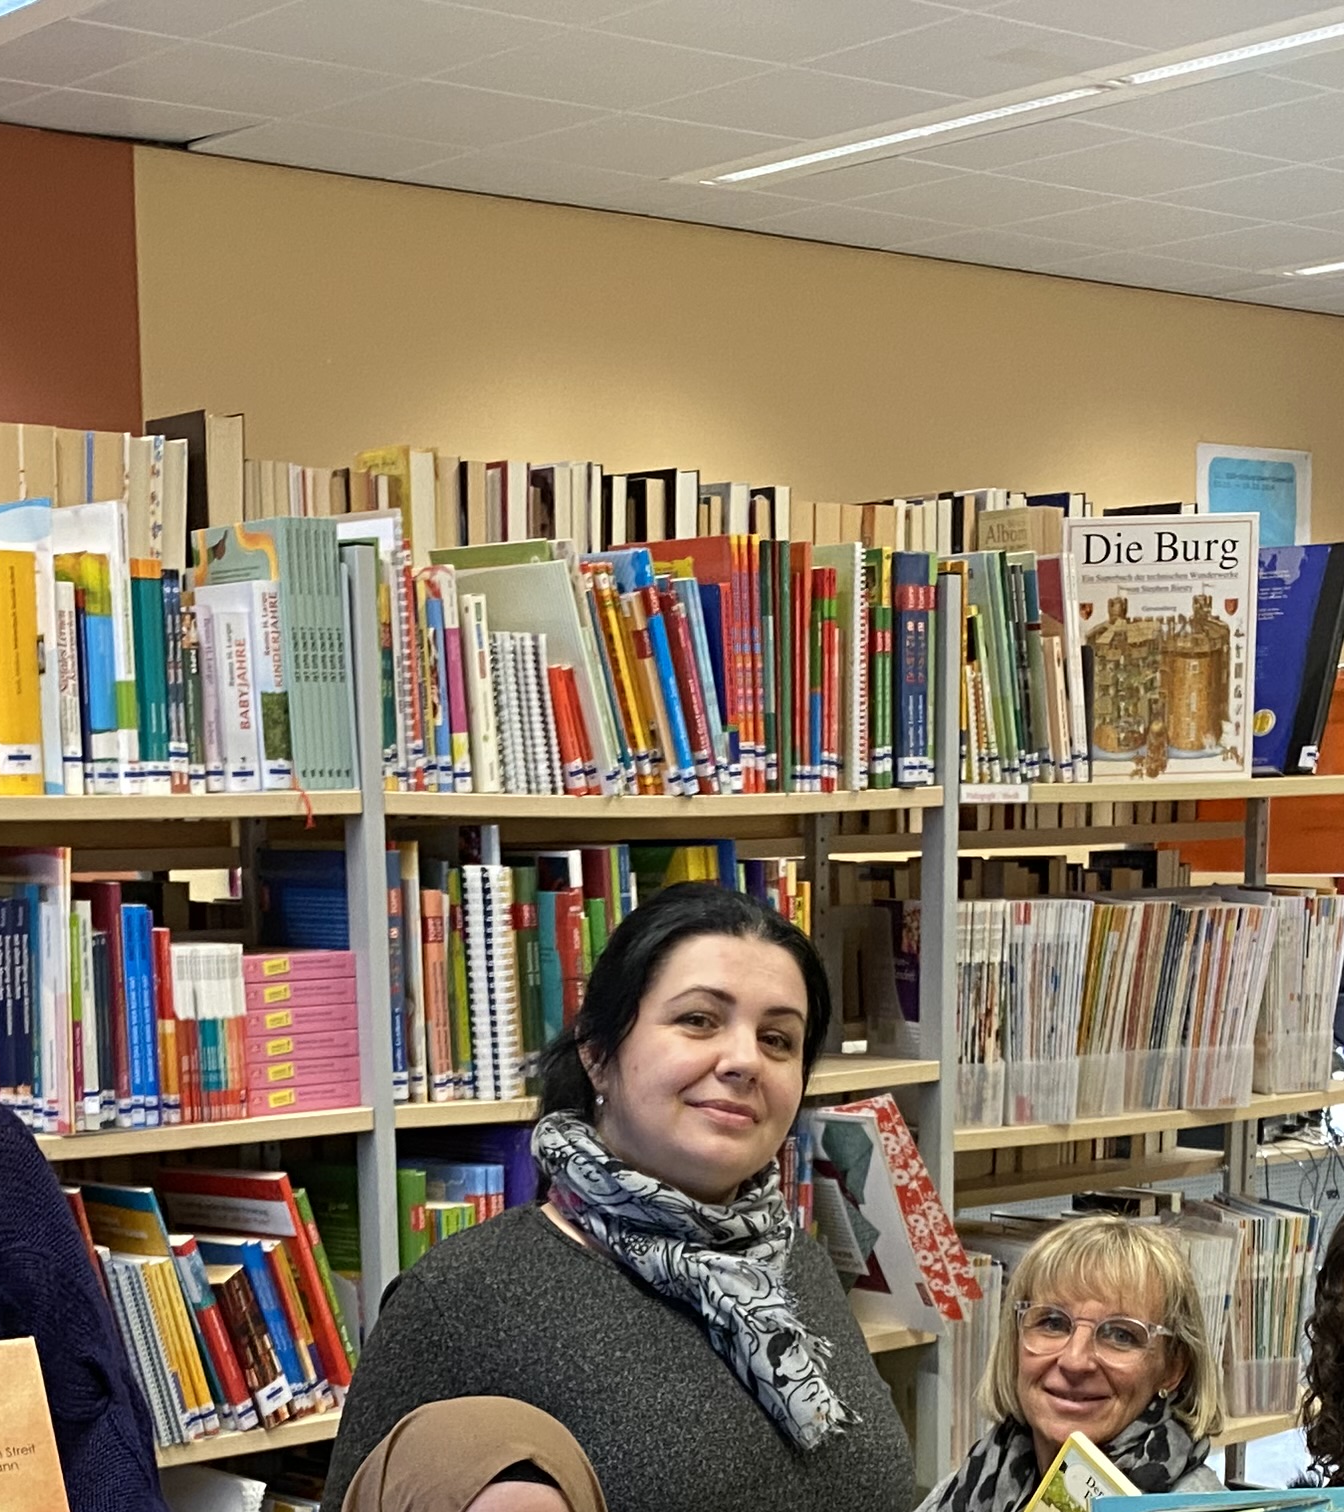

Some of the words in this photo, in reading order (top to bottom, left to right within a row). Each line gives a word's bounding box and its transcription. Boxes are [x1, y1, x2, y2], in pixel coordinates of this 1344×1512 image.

[1081, 532, 1144, 566] Die
[1153, 530, 1240, 570] Burg
[267, 591, 284, 688] KINDERJAHRE
[235, 638, 252, 730] BABYJAHRE
[5, 1443, 37, 1458] Streit
